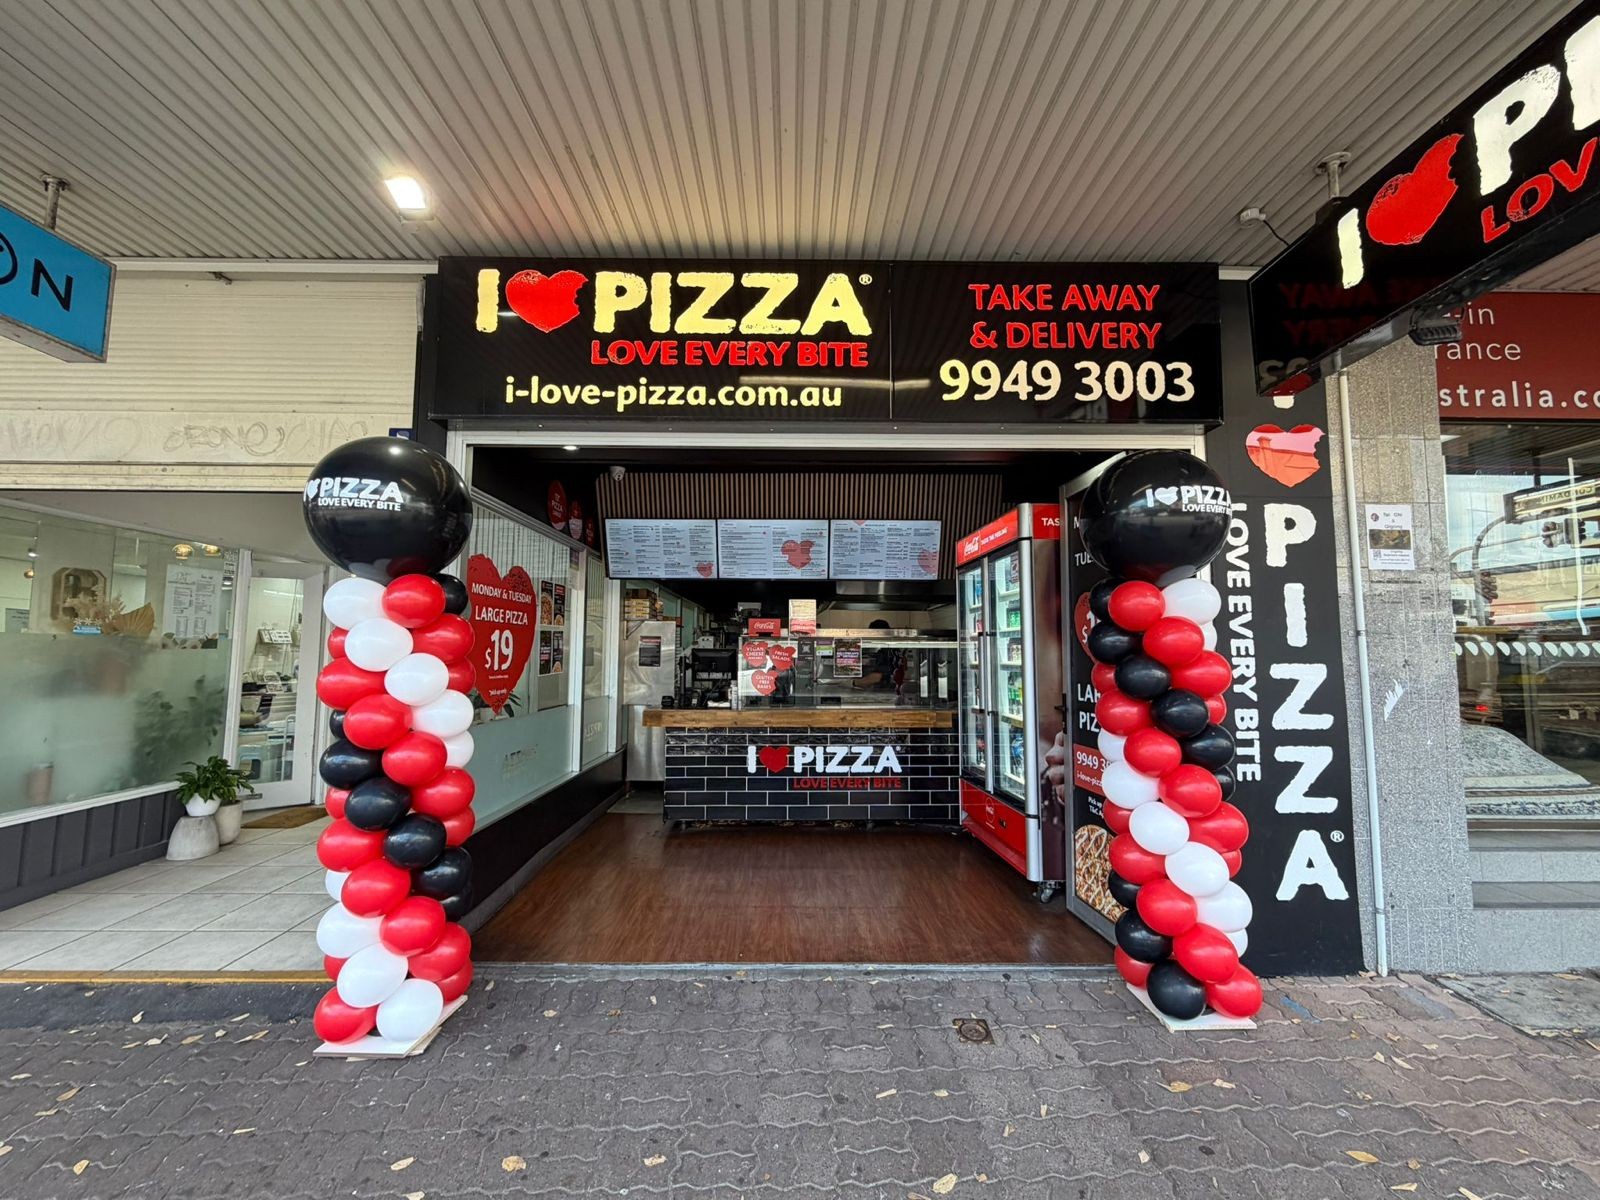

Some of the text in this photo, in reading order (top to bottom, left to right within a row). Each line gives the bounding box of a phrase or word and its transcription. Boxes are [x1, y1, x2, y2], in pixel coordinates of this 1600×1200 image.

[1481, 135, 1599, 244] LOV
[1337, 207, 1364, 289] I
[476, 268, 500, 333] I
[968, 284, 1161, 311] TAKE AWAY
[970, 321, 1162, 349] & DELIVERY
[591, 340, 868, 368] LOVE EVERY BITE
[505, 376, 842, 412] i-love-pizza.com.au
[939, 359, 1195, 402] 9949 3003
[320, 477, 404, 503] PIZZA
[318, 498, 401, 511] LOVE EVERY BITE
[1182, 504, 1206, 512] LOVE
[472, 583, 532, 604] MONDAY & TUESDAY
[475, 605, 528, 625] LARGE PIZZA
[484, 629, 513, 671] $19
[1229, 595, 1258, 701] EVERY
[747, 745, 757, 773] I
[1234, 709, 1262, 782] BITE
[1076, 751, 1099, 770] 9949
[794, 778, 902, 788] LOVE EVERY BITE
